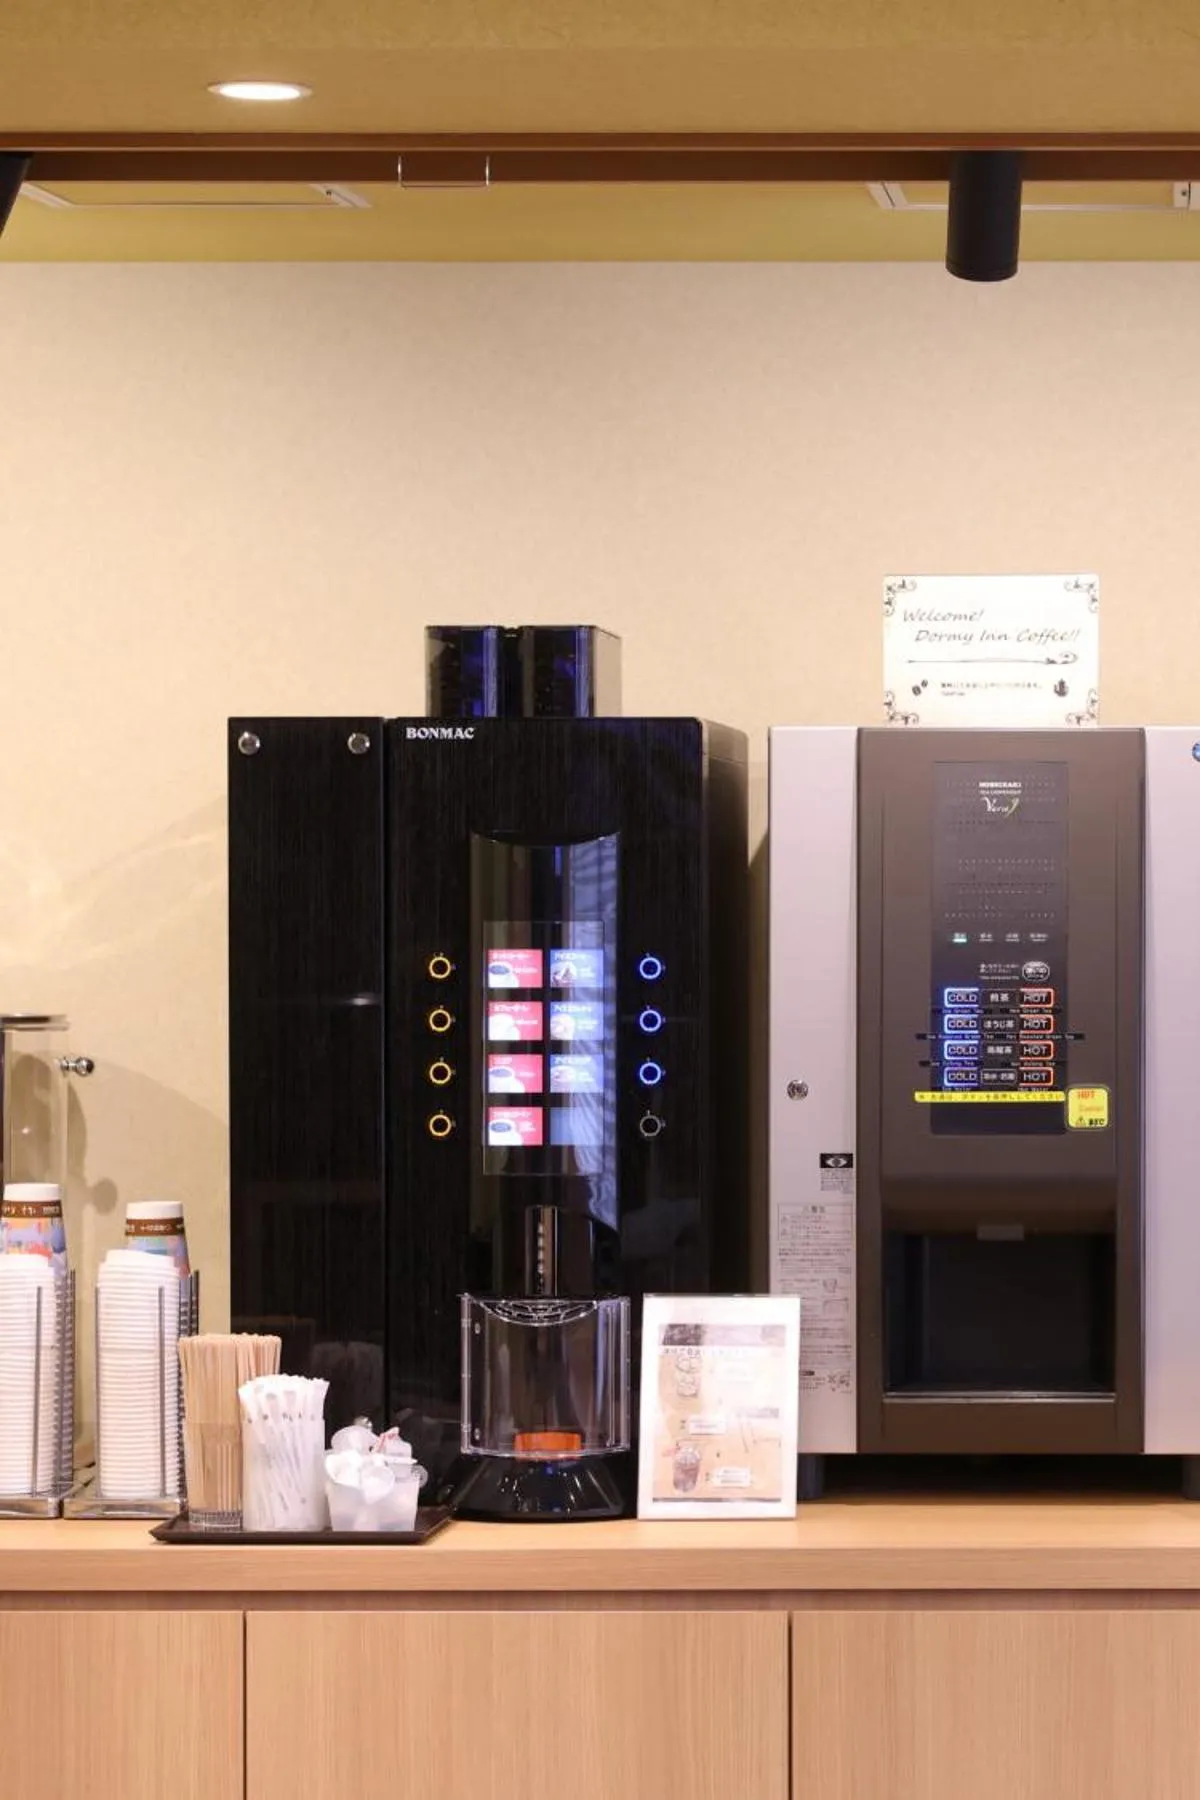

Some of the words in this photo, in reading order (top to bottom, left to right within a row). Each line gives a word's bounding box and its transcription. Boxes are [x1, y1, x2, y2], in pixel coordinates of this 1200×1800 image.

[903, 608, 985, 623] Welcome!
[914, 629, 975, 646] Dormy
[979, 629, 1009, 643] Inn
[1016, 627, 1081, 646] Coffee!!
[405, 726, 476, 740] BONMAC
[948, 993, 977, 1002] COLD
[1023, 993, 1048, 1002] HOT
[948, 1019, 977, 1028] COLD
[1023, 1019, 1048, 1028] HOT
[948, 1045, 977, 1054] COLD
[1023, 1045, 1048, 1054] HOT
[948, 1072, 977, 1081] COLD
[1023, 1072, 1048, 1081] HOT
